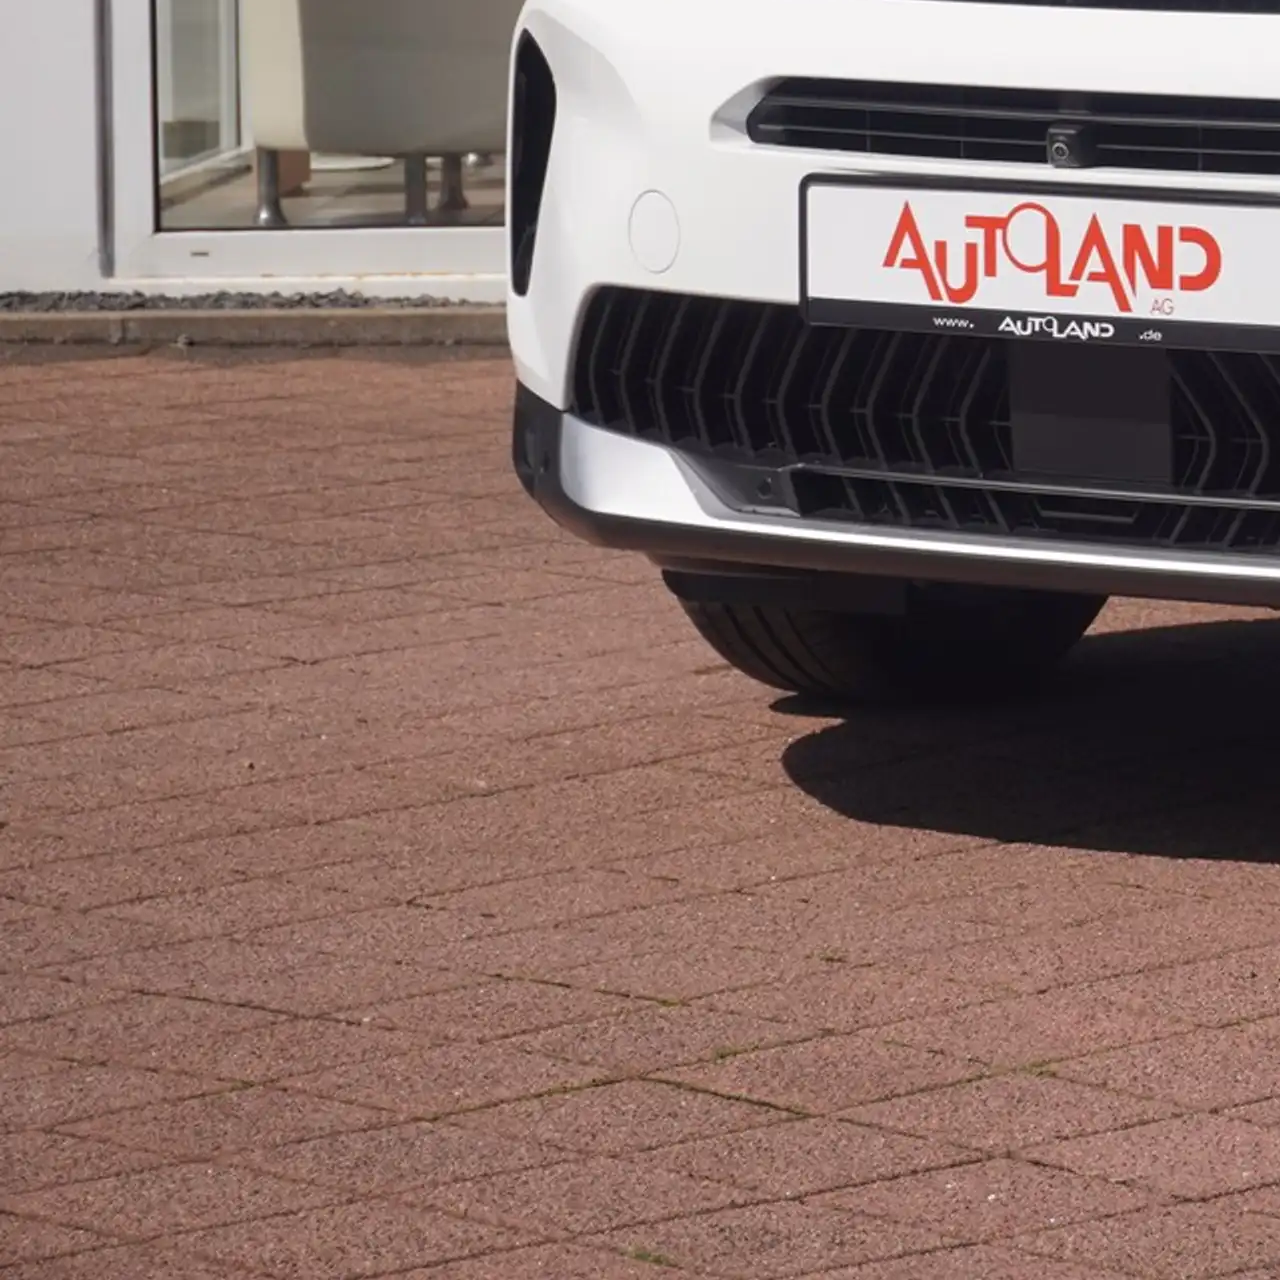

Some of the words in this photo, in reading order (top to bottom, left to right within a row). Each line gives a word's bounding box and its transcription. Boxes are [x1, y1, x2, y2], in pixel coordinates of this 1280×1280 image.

[883, 201, 1222, 313] AUTOLAND
[1150, 297, 1175, 316] AG
[932, 317, 975, 329] www.
